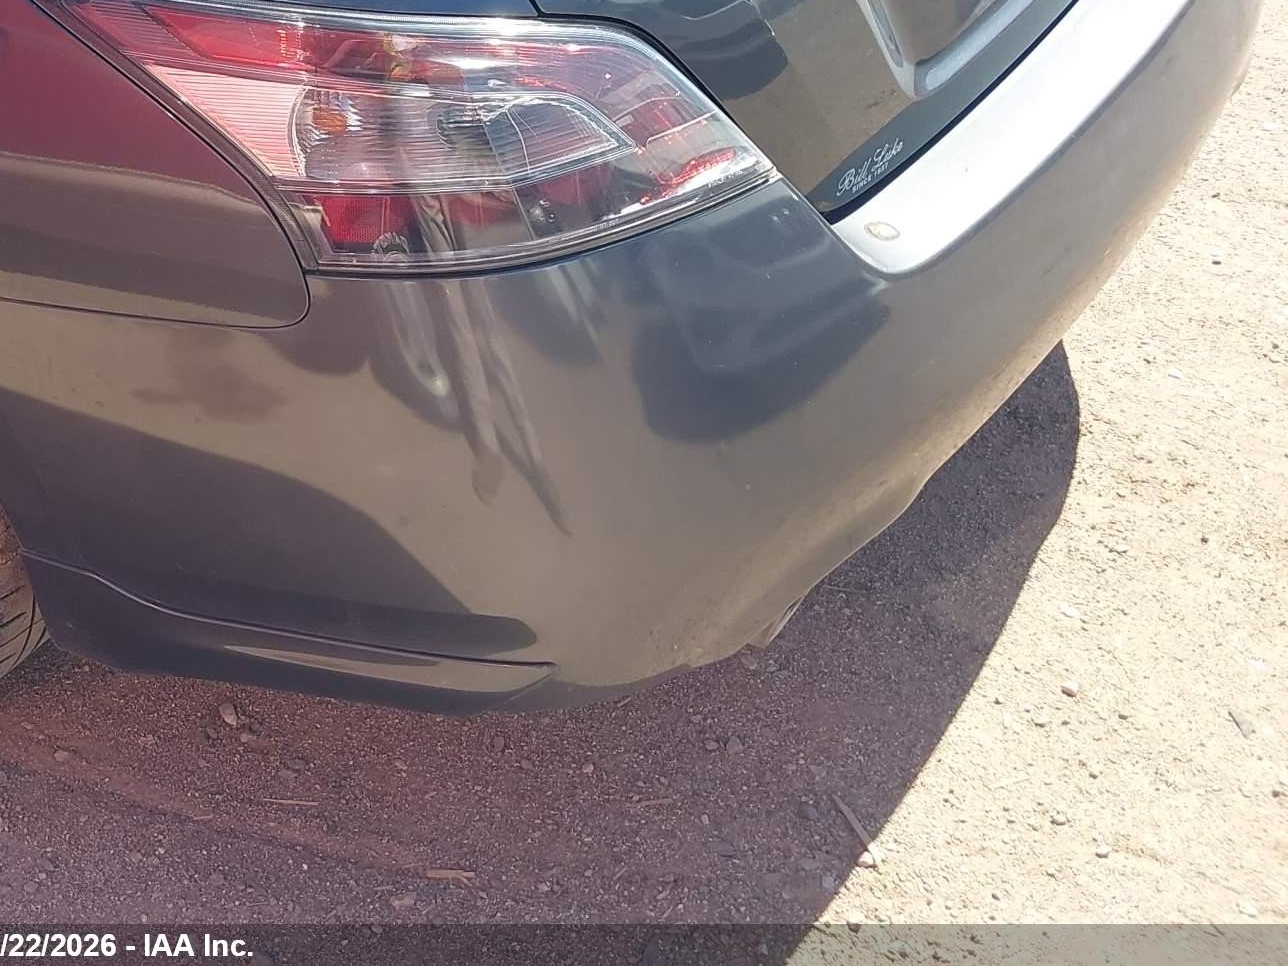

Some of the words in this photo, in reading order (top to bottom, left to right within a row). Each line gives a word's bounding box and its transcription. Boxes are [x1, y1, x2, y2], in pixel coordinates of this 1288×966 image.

[836, 157, 872, 196] Bill
[871, 137, 904, 172] Luke
[852, 174, 872, 194] SINCE
